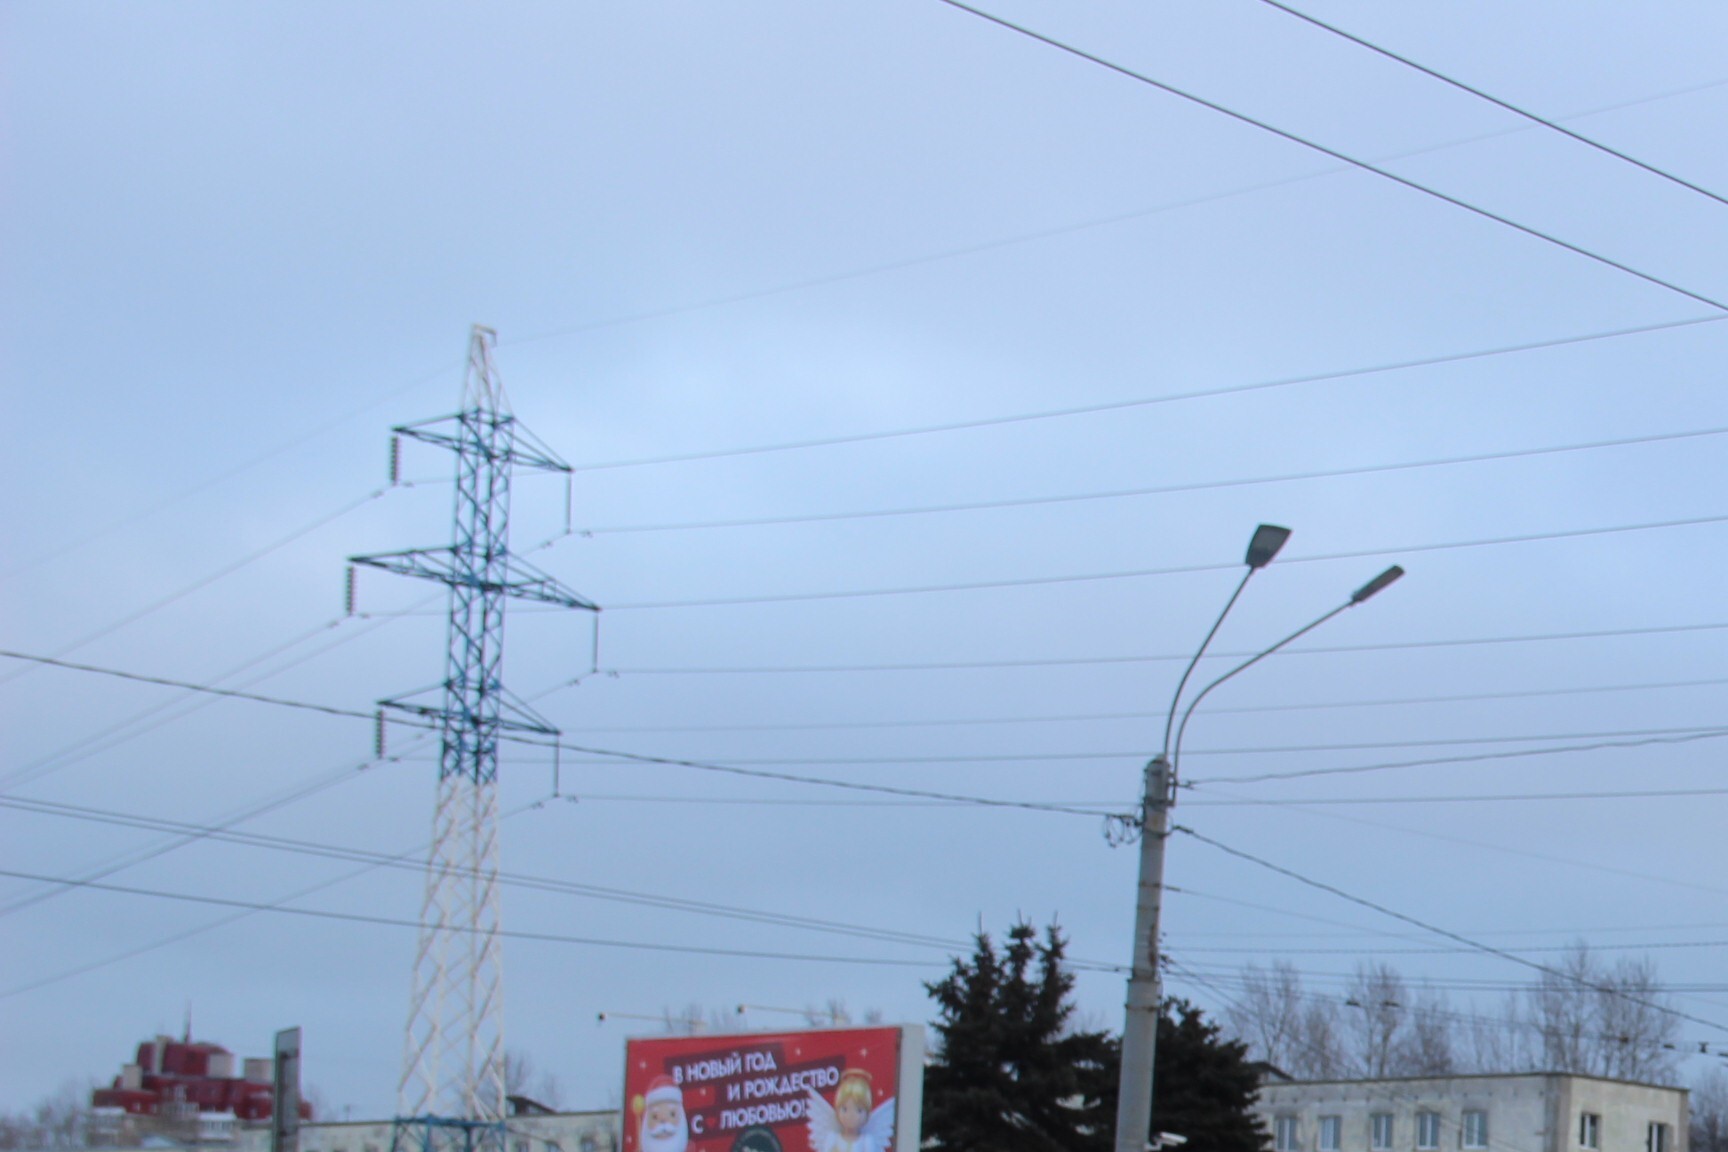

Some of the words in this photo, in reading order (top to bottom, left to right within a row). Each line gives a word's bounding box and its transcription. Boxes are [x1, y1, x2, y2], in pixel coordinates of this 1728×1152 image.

[672, 1066, 683, 1084] В
[687, 1053, 742, 1082] НОВЫЙ
[745, 1052, 777, 1072] ГОД
[727, 1084, 740, 1101] И
[744, 1066, 840, 1099] РОЖДЕСТВО
[691, 1115, 703, 1134] С
[720, 1099, 806, 1130] ЛЮБОВЬЮ!
